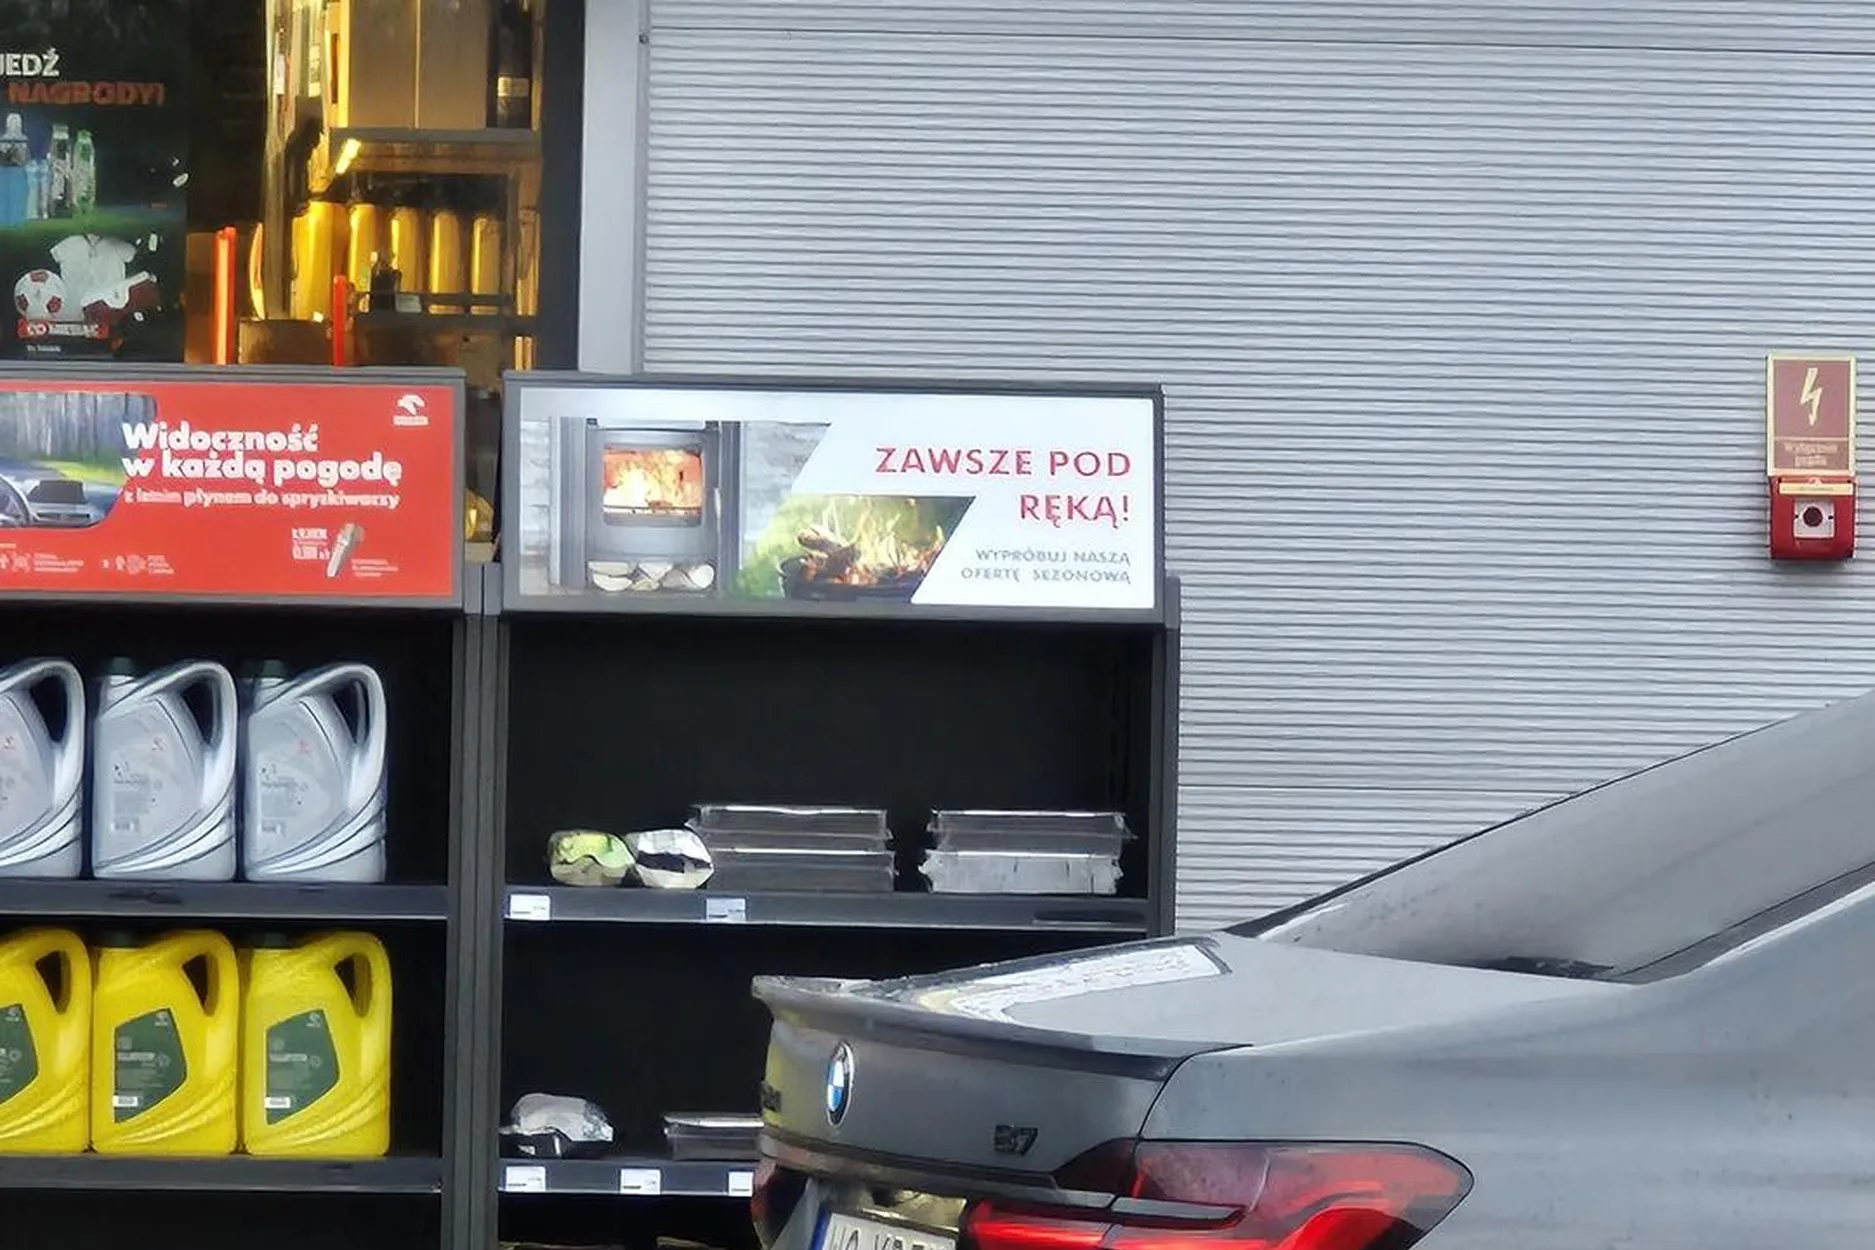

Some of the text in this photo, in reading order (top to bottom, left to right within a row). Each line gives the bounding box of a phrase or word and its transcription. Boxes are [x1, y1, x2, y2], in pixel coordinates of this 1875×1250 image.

[121, 421, 319, 452] Widoczność
[121, 449, 403, 489] w każdą pogodę
[875, 447, 1131, 477] ZAWSZE POD
[254, 488, 280, 505] do
[1020, 494, 1129, 529] RĘKĄ!
[975, 547, 1131, 567] WYPRÓBUJ NASZĄ
[961, 567, 1131, 584] OFERTĘ SEZONOWĄ
